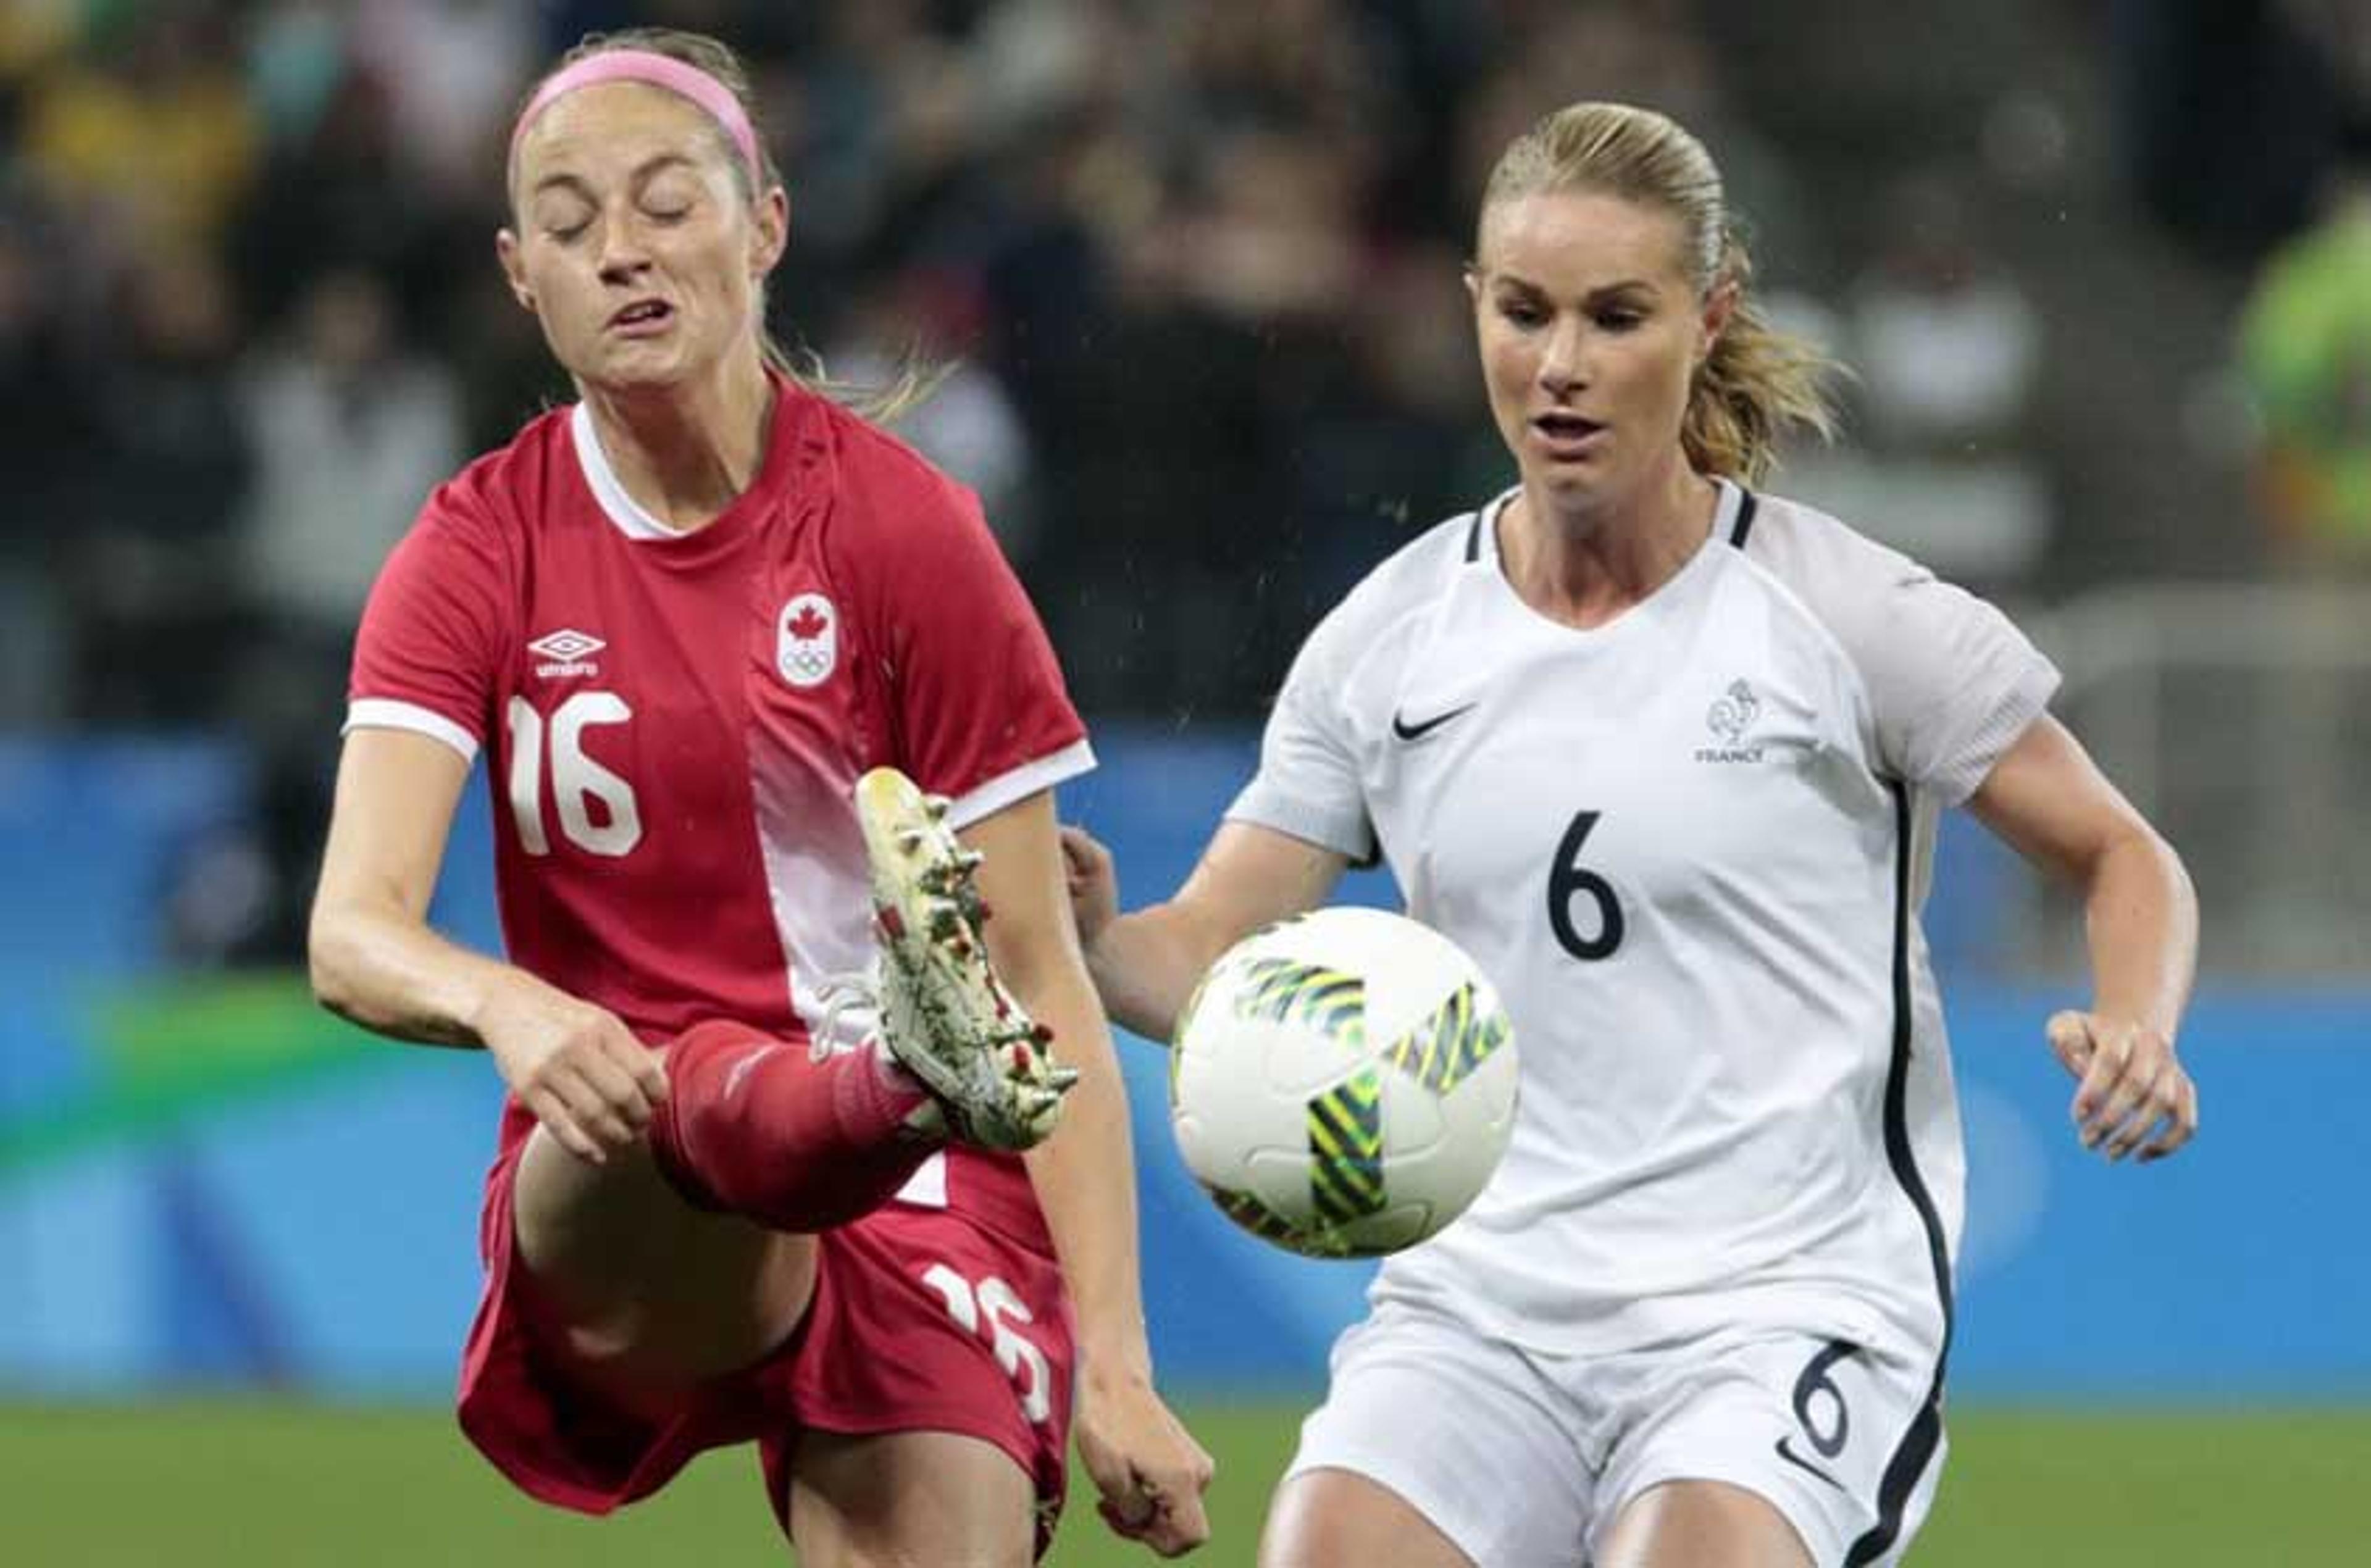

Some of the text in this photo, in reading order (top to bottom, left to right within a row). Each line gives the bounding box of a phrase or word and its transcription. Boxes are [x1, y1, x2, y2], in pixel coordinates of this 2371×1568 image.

[508, 691, 643, 856] 16
[1547, 810, 1625, 962] 6
[922, 1263, 1050, 1423] 16
[1792, 1338, 1860, 1458] 6
